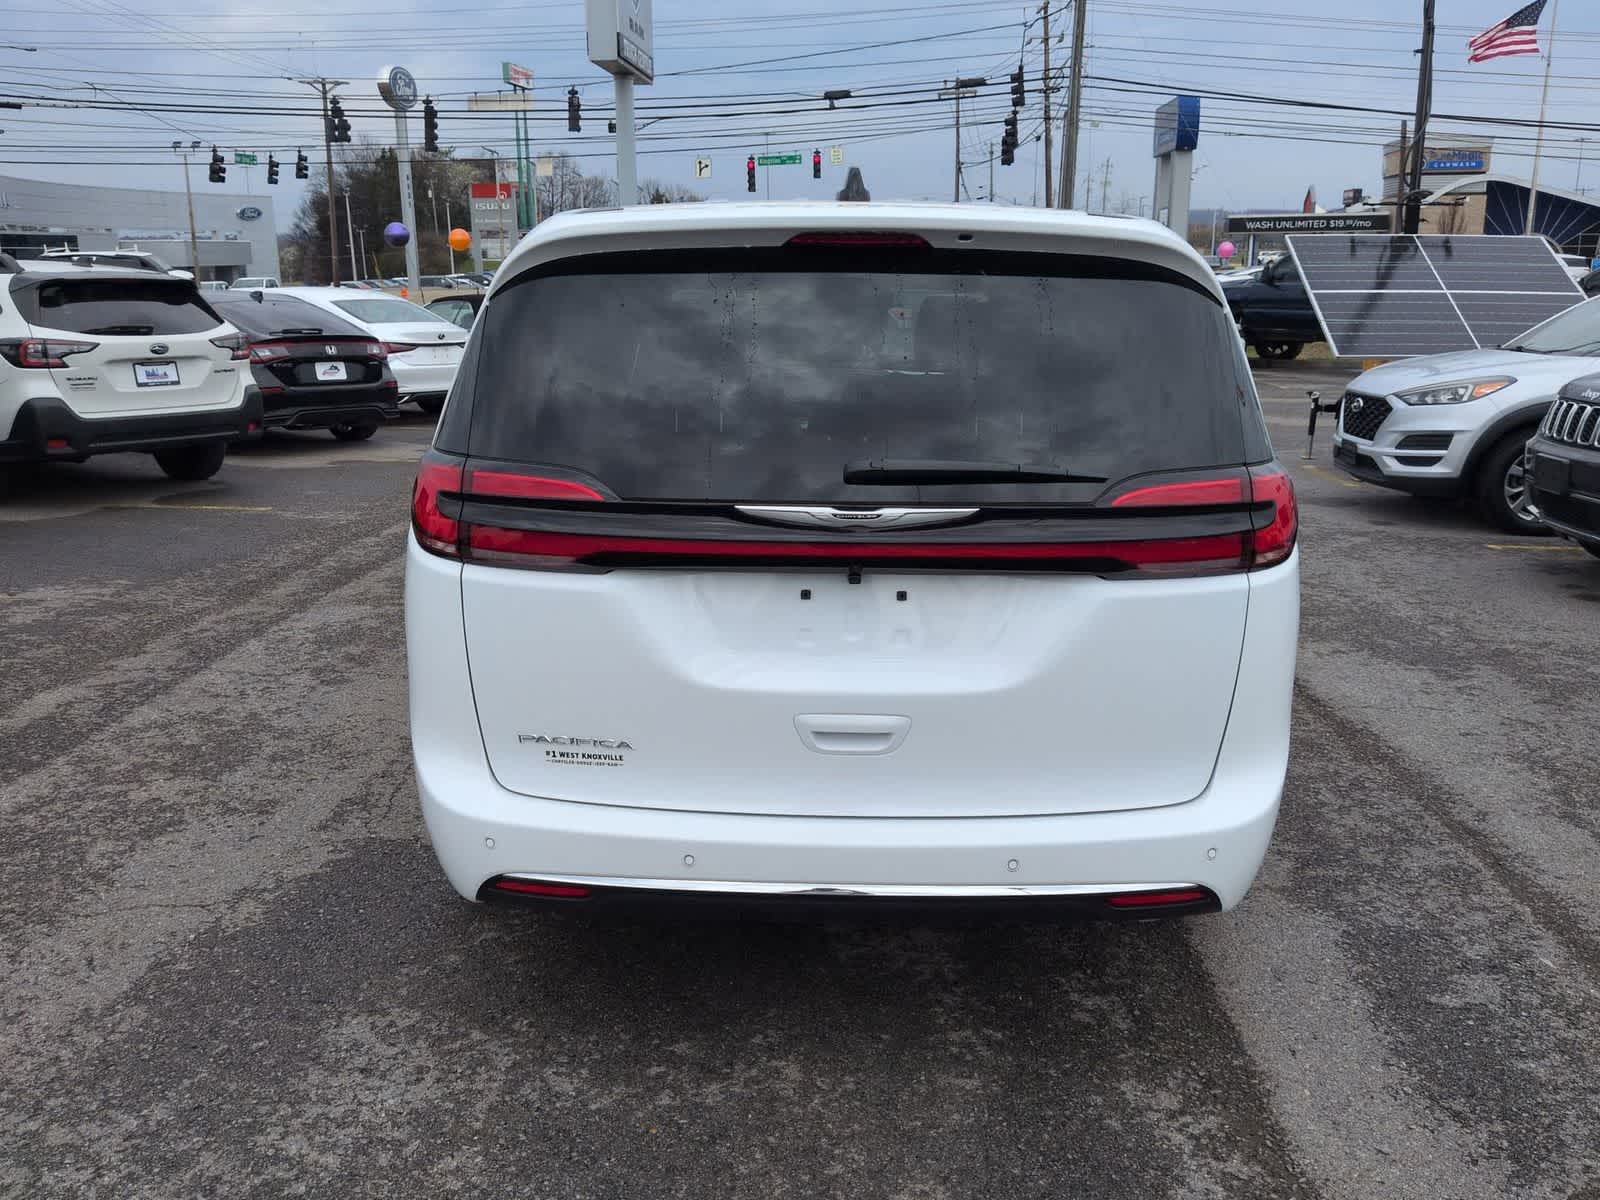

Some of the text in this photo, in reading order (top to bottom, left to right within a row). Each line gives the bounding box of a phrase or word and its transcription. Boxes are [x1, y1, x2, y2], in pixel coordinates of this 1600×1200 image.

[1245, 220, 1274, 230] WASH
[1276, 219, 1327, 229] UNLIMITED
[518, 733, 634, 750] PACIFICA
[559, 751, 579, 759] WEST
[581, 752, 624, 762] KNOXVILLE
